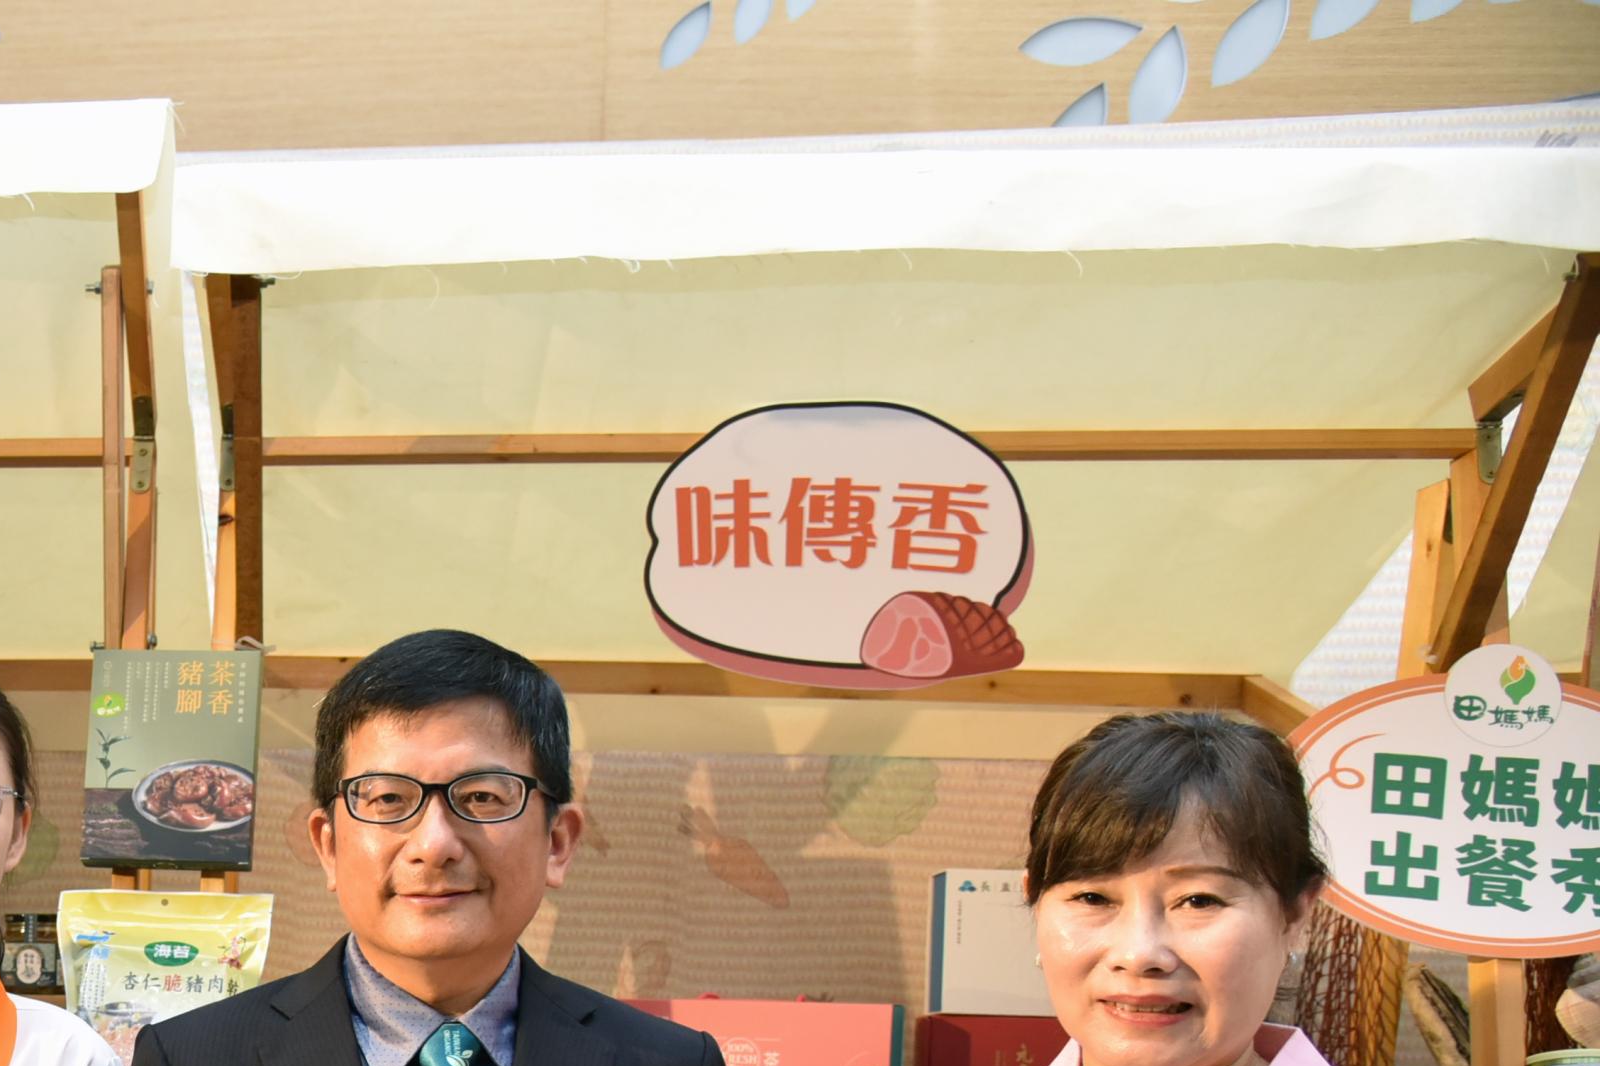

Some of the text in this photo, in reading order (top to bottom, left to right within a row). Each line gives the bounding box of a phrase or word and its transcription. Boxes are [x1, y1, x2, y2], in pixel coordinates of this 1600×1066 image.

[675, 476, 990, 574] 味傳香
[176, 660, 204, 714] 豬腳
[207, 660, 235, 715] 茶香
[1452, 694, 1554, 730] 田媽媽
[154, 944, 191, 958] 海苔
[122, 971, 239, 996] 杏仁脆豬肉乾
